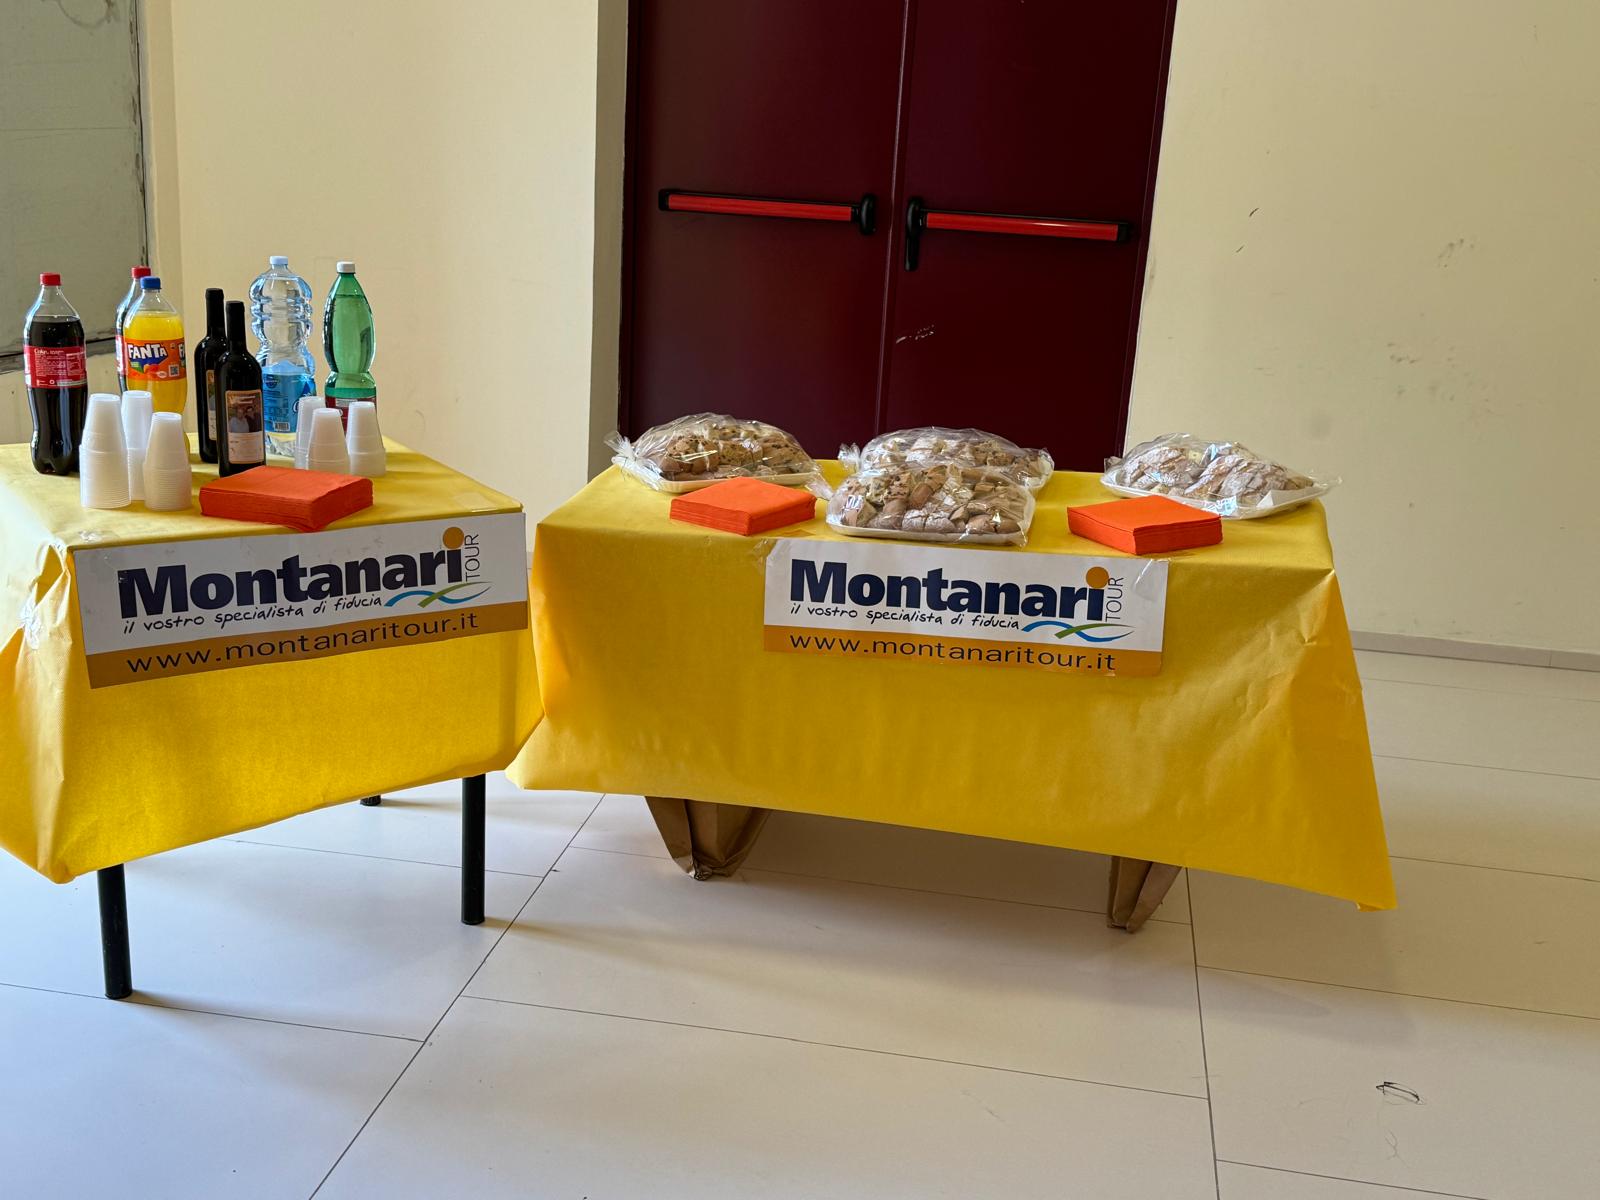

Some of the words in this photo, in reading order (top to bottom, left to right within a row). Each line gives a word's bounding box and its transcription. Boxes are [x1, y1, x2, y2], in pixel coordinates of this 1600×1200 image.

[127, 343, 167, 360] FANTA
[118, 526, 465, 618] Montanari
[464, 534, 480, 582] TOUR
[791, 559, 1108, 621] Montanari
[1105, 577, 1124, 622] TOUR
[123, 620, 134, 635] il
[144, 615, 205, 631] vostro
[214, 605, 304, 629] specialista
[313, 600, 326, 613] di
[334, 595, 383, 611] fiducia
[790, 603, 801, 615] il
[807, 606, 858, 618] vostro
[866, 608, 943, 625] specialista
[951, 614, 964, 625] di
[971, 613, 1020, 630] fiducia
[127, 612, 479, 673] www.montanaritour.it
[791, 635, 1115, 670] www.montanaritour.it
